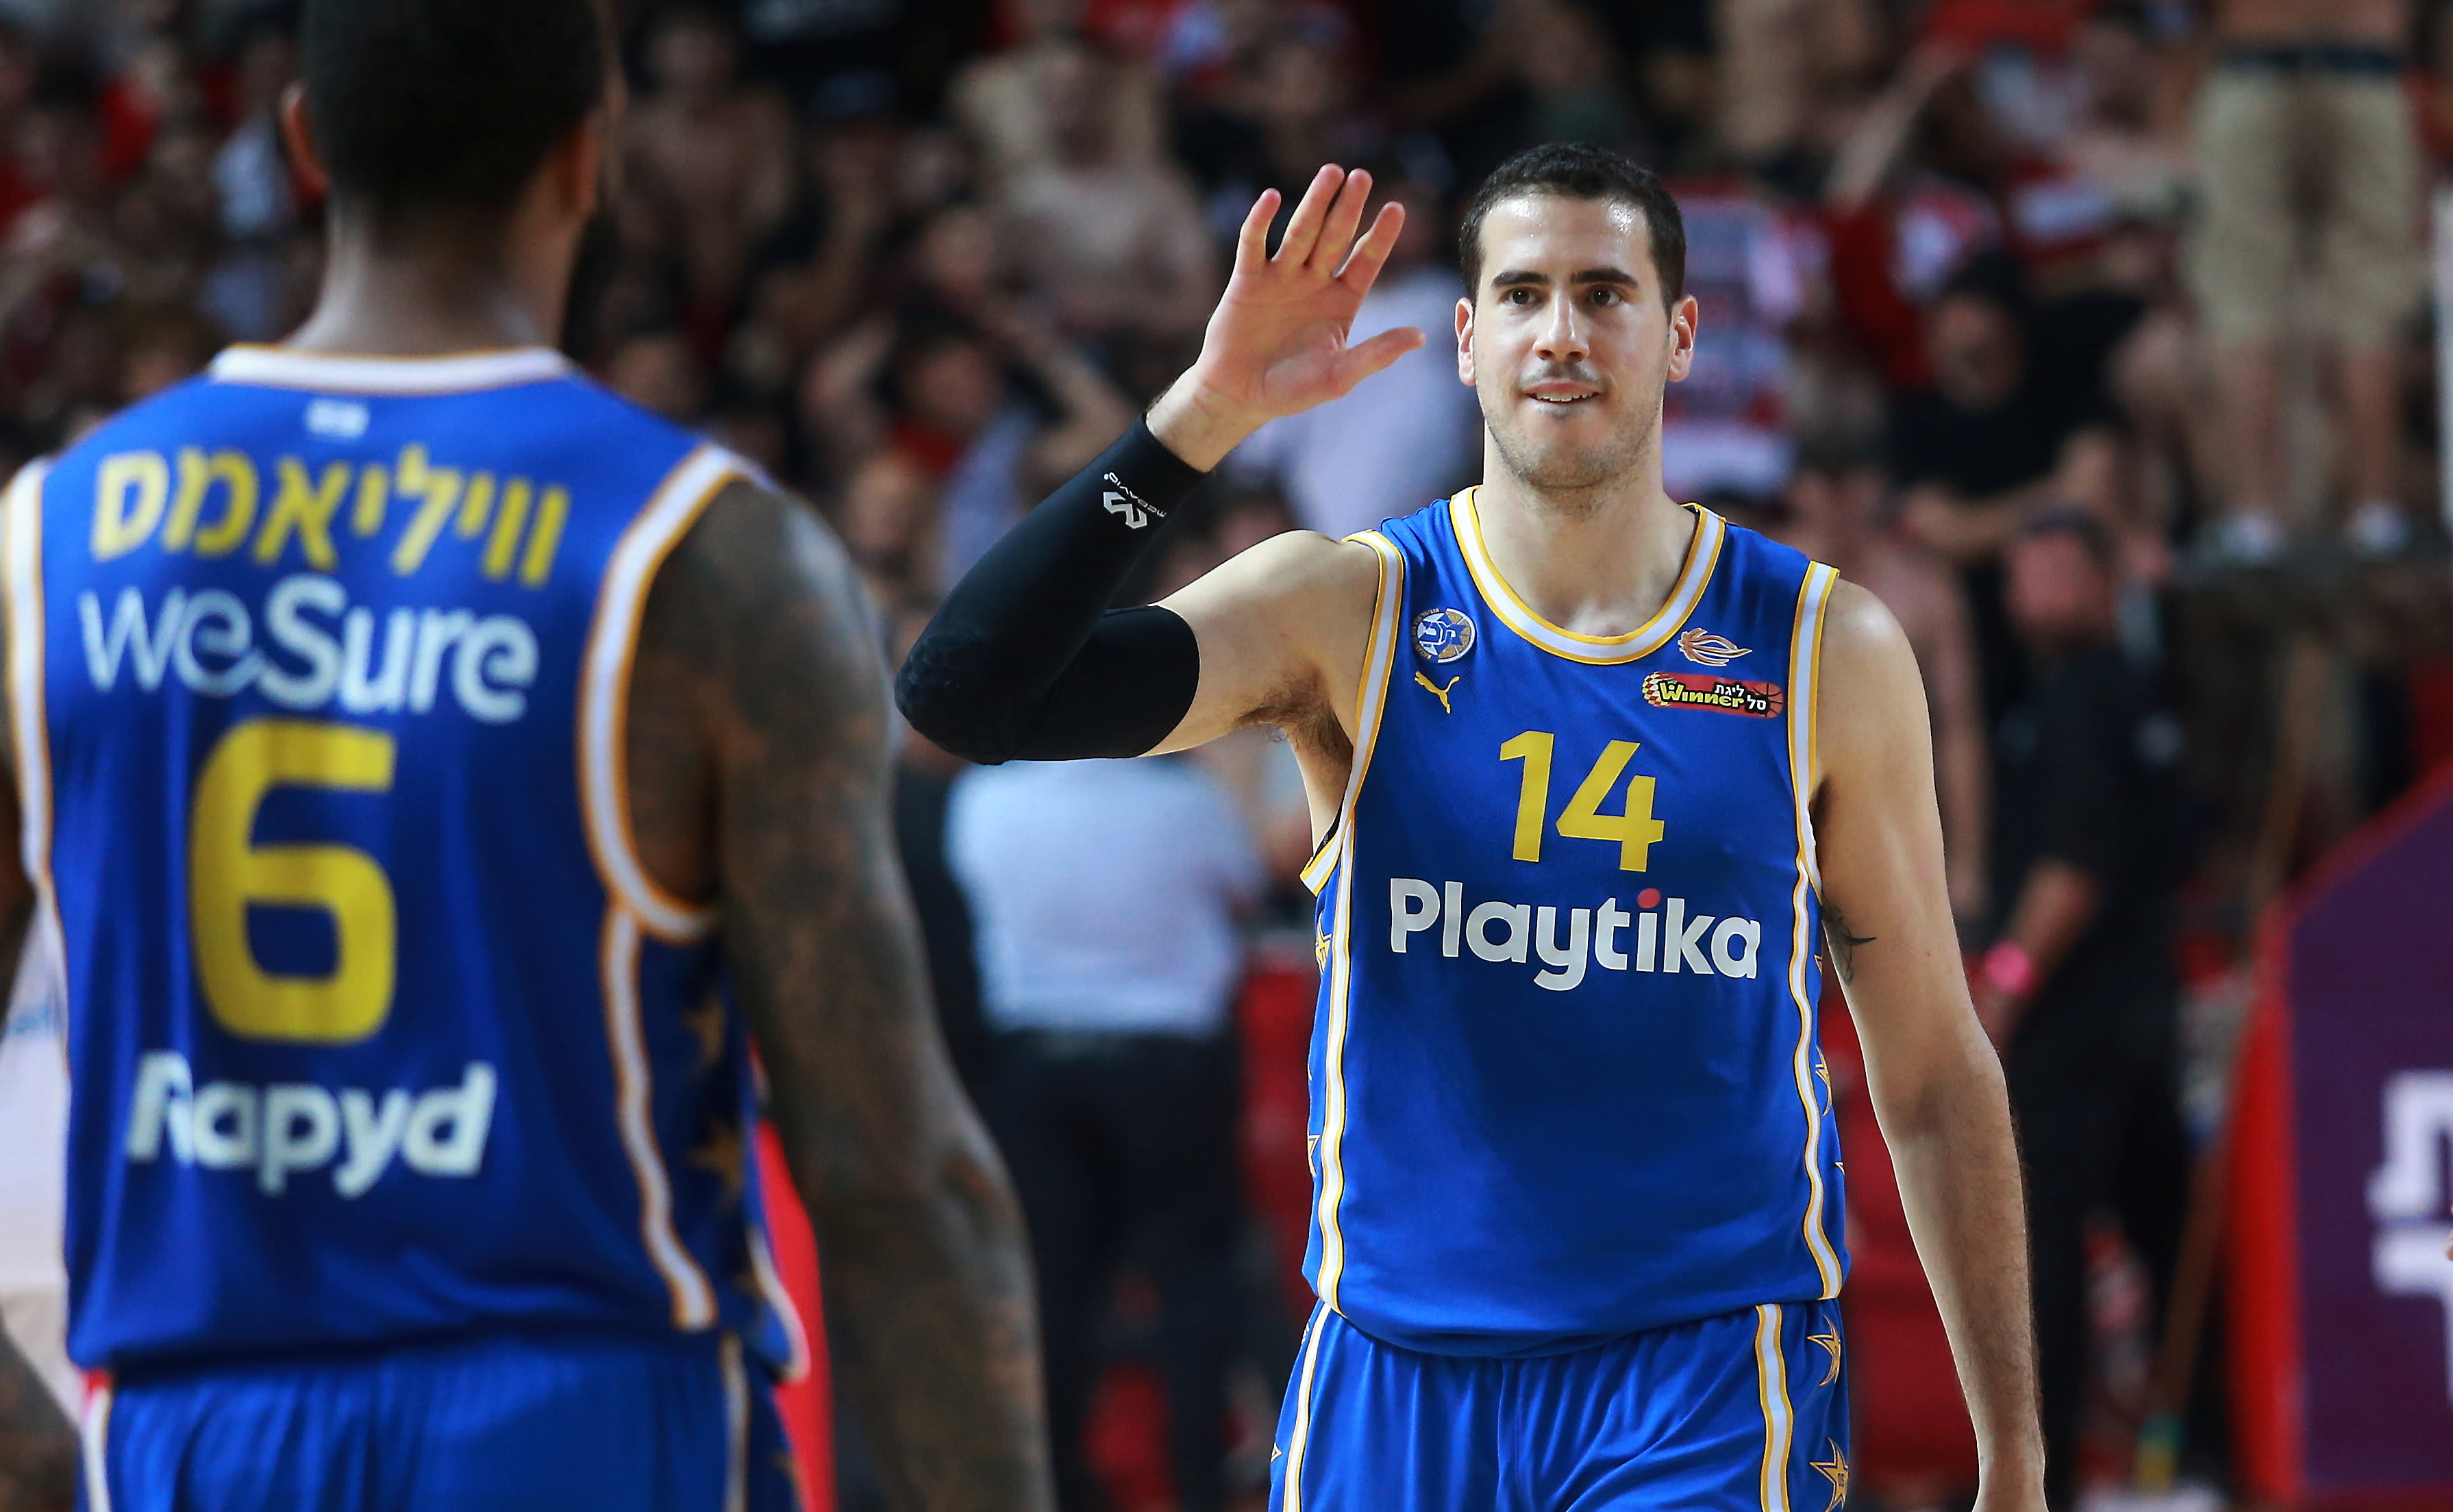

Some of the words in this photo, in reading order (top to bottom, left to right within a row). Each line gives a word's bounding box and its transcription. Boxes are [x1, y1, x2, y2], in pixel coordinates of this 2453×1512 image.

[90, 444, 570, 587] וויליאמס
[77, 575, 539, 723] weSure
[1659, 682, 1745, 707] Winner
[1714, 684, 1745, 697] ליגת
[1747, 694, 1767, 711] סל
[1499, 730, 1665, 872] 14
[189, 716, 397, 1046] 6
[1390, 878, 1761, 992] Playtika
[127, 1050, 497, 1198] Rapyd
